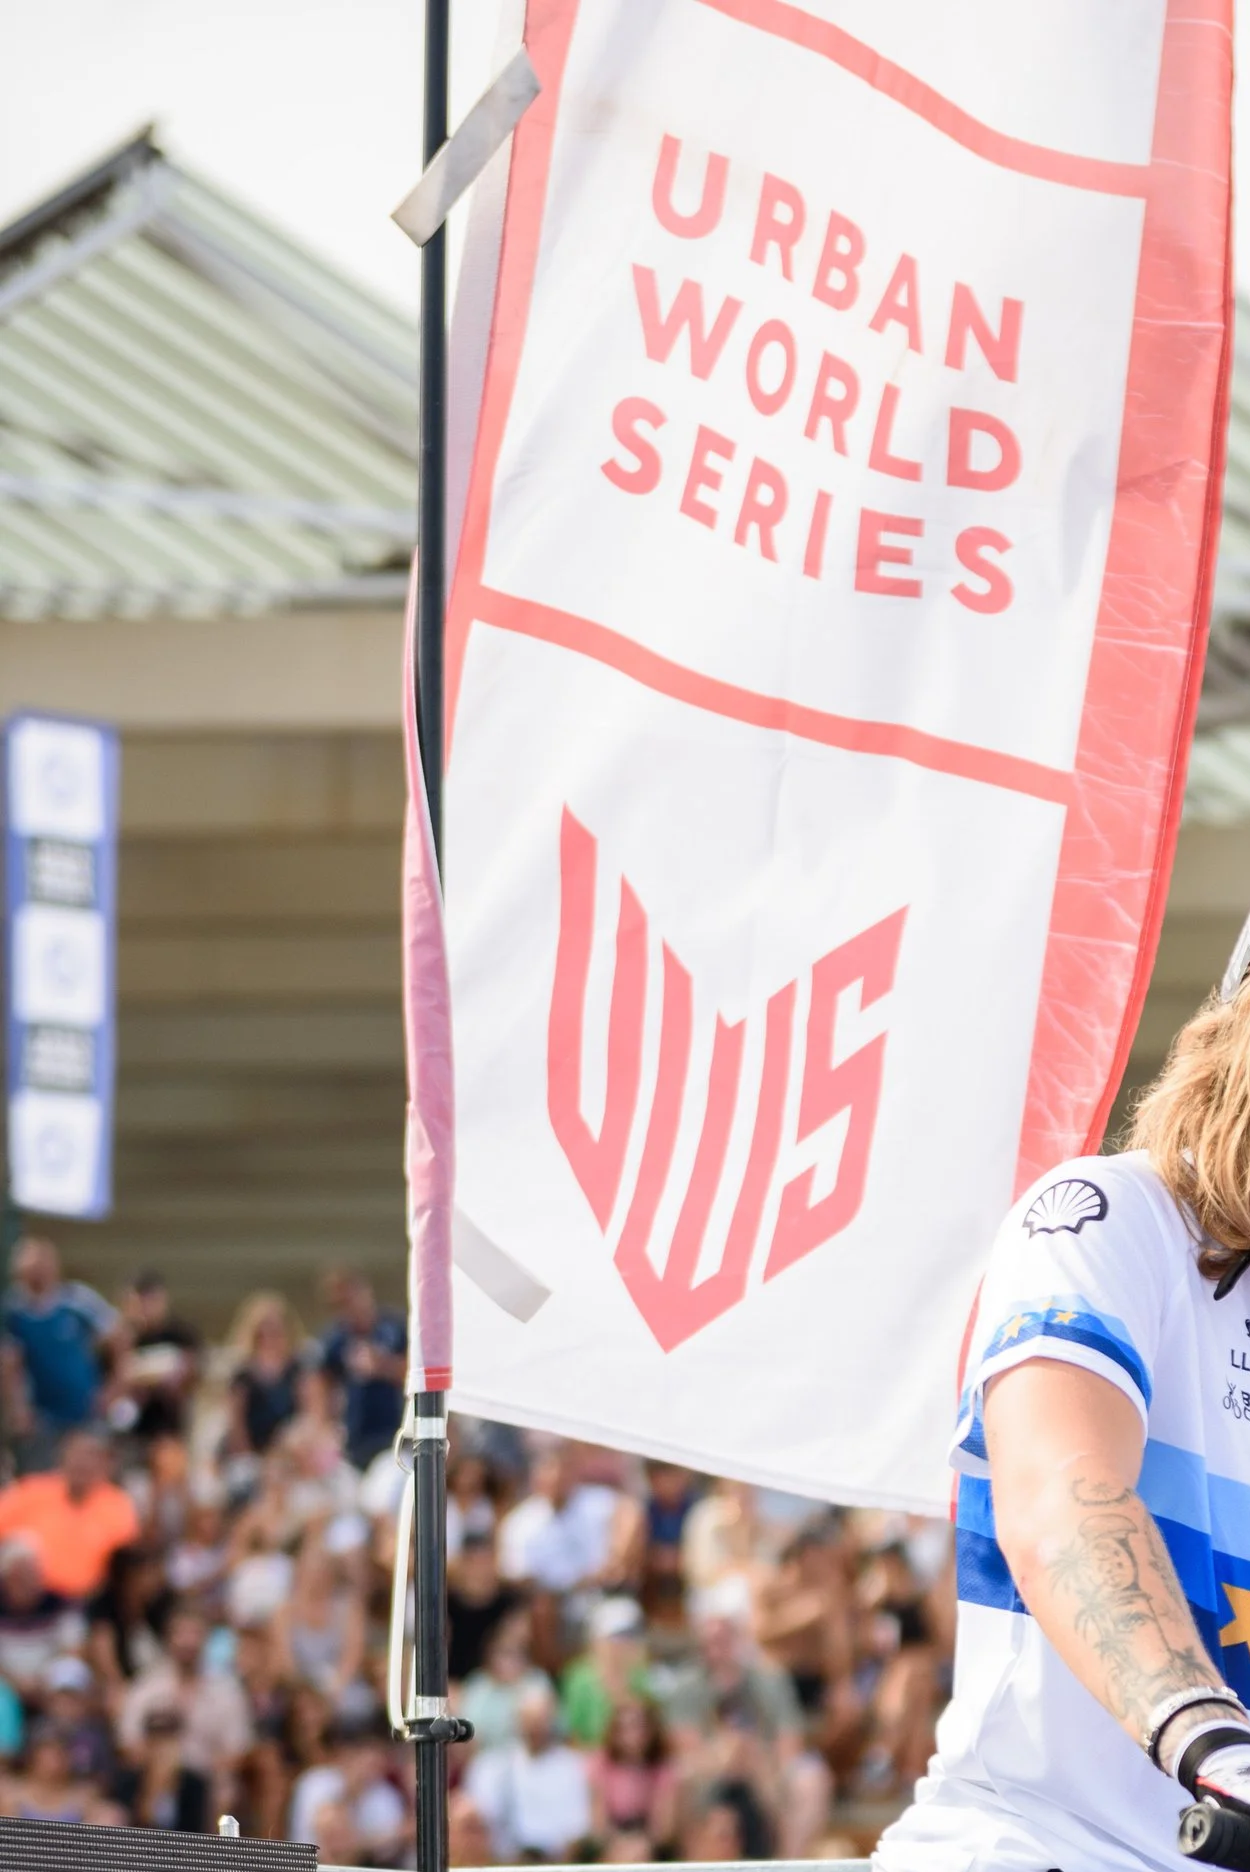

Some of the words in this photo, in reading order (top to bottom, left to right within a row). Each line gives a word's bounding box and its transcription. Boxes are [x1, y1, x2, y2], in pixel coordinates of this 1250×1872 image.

[651, 132, 1025, 385] URBAN
[631, 262, 1022, 492] WORLD
[600, 396, 1014, 615] SERIES
